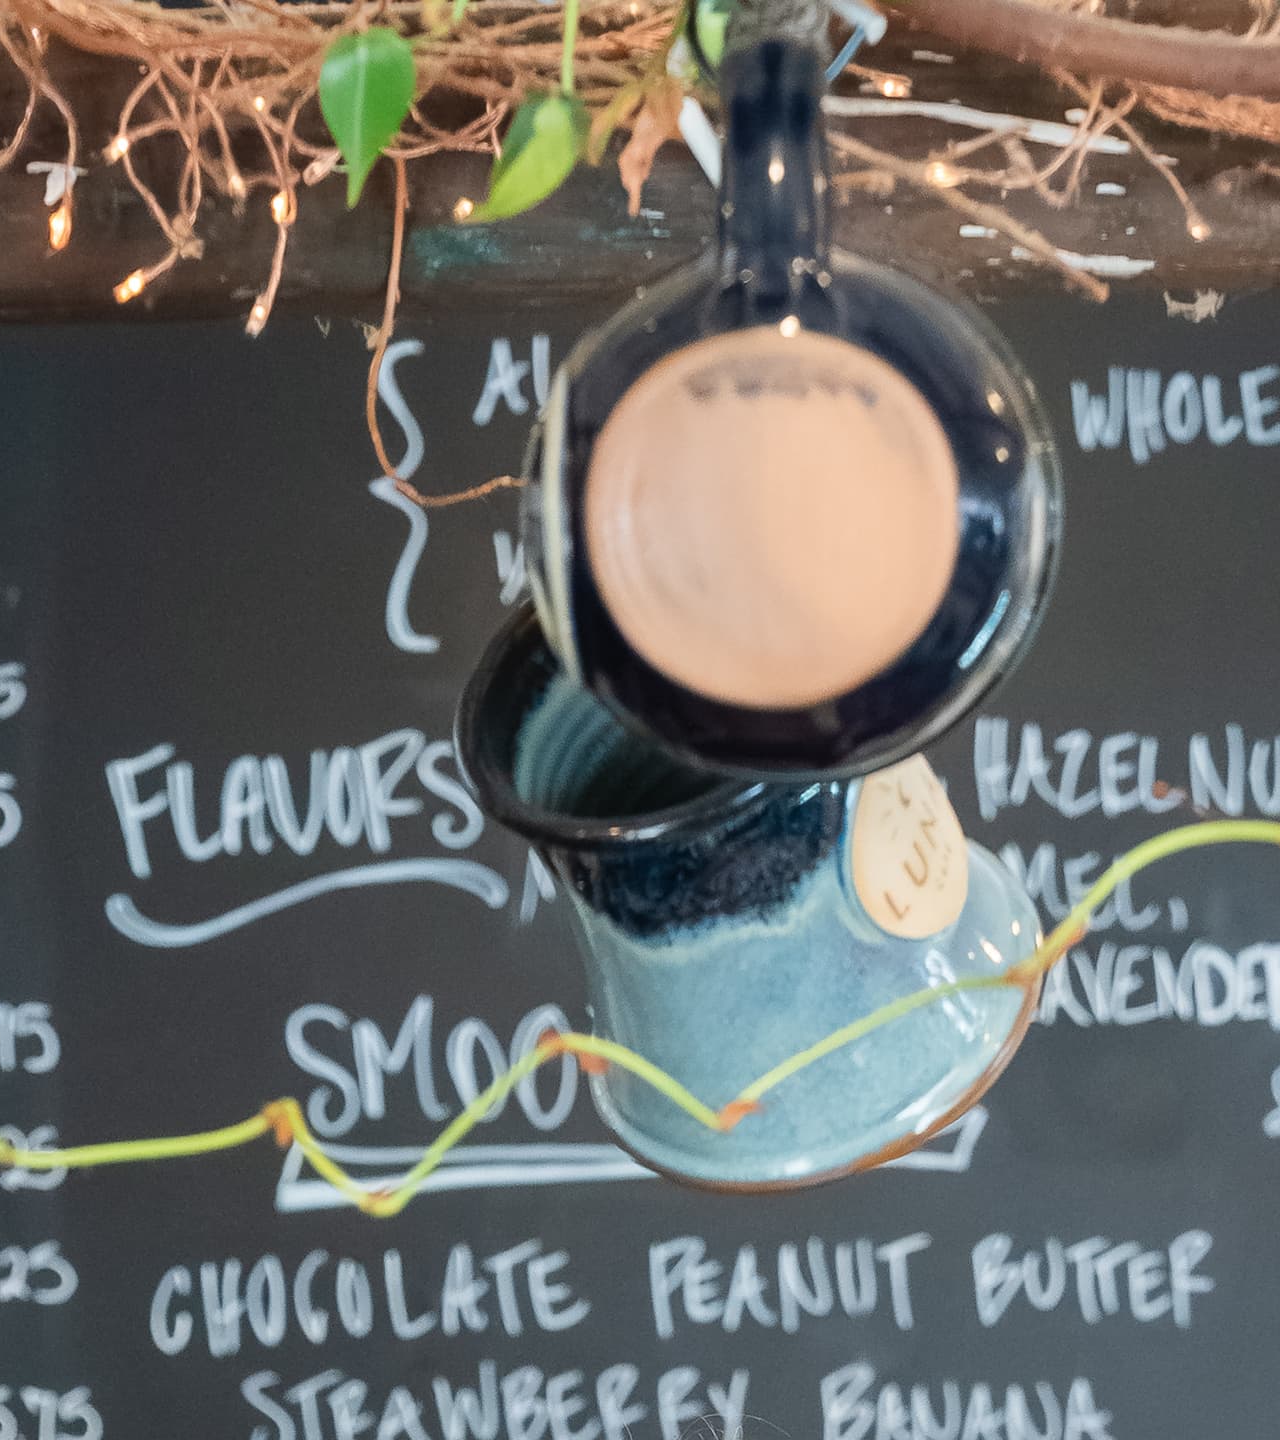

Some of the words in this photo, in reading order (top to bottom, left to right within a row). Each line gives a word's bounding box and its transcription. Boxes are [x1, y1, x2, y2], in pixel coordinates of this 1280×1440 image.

[105, 727, 484, 879] FLAVORS
[283, 993, 584, 1138] SMOO
[150, 1237, 592, 1358] CHOCOLATE
[648, 1230, 934, 1342] PEANUT
[970, 1227, 1216, 1330] BUTTER
